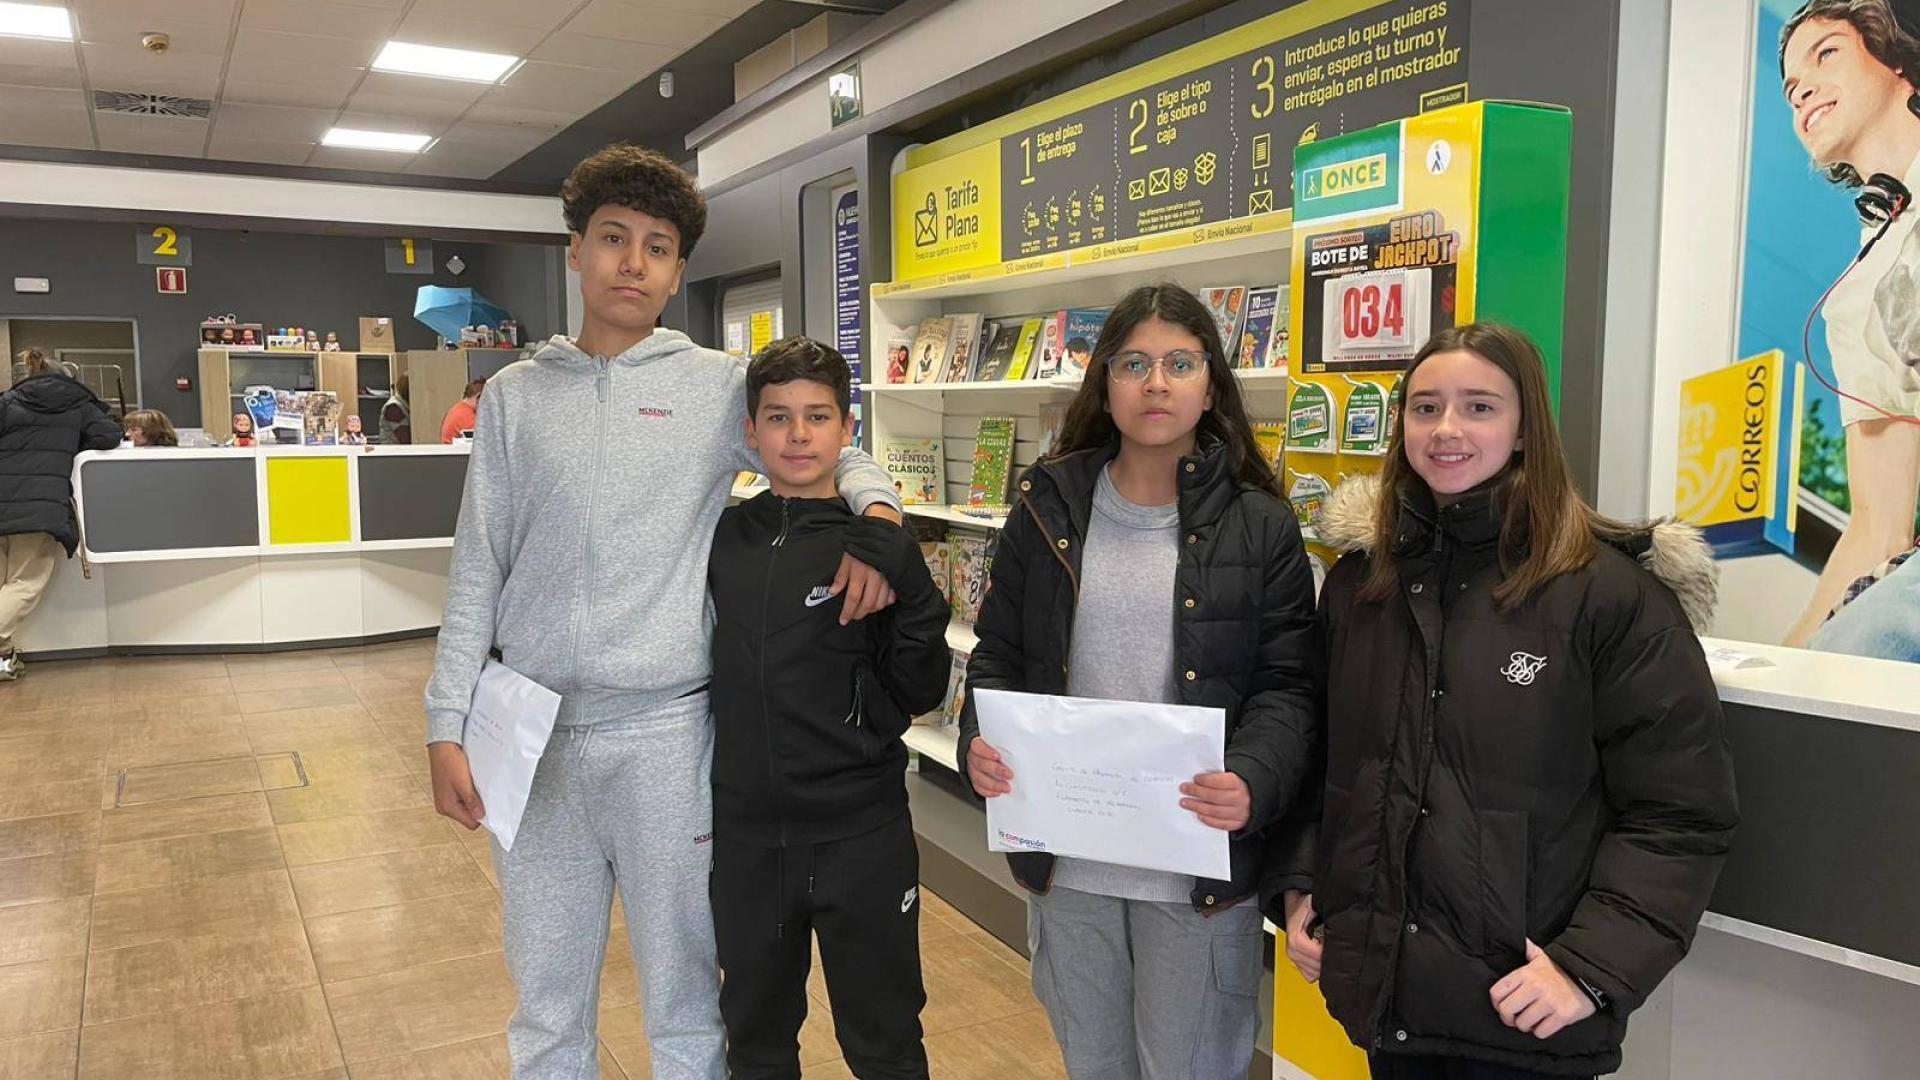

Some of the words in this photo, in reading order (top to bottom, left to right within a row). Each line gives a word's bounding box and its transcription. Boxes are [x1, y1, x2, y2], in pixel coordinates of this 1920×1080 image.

[1284, 35, 1345, 67] Introduce
[1348, 27, 1360, 46] lo
[1363, 22, 1388, 43] que
[1392, 1, 1447, 32] quieras
[1284, 62, 1325, 89] enviar,
[1327, 50, 1372, 76] espera
[1376, 43, 1390, 61] tu
[1393, 32, 1435, 56] turno
[1436, 26, 1447, 48] y
[1251, 55, 1275, 119] 3
[1284, 79, 1344, 112] entrégalo
[1346, 77, 1363, 93] en
[1366, 72, 1377, 88] el
[1380, 47, 1461, 85] mostrador
[1157, 91, 1179, 109] Elige
[1181, 86, 1190, 102] el
[1191, 80, 1211, 99] tipo
[1426, 91, 1462, 107] MOSTRADOR
[1129, 99, 1148, 154] 2
[1157, 111, 1170, 126] de
[1170, 103, 1198, 122] sobre
[1199, 101, 1207, 113] o
[1037, 131, 1054, 148] Elige
[1055, 126, 1062, 142] el
[1063, 123, 1083, 142] plazo
[1157, 126, 1177, 145] caja
[1020, 137, 1035, 185] 1
[1037, 149, 1046, 162] de
[1047, 141, 1076, 158] entrega
[1326, 161, 1380, 190] ONCE
[945, 180, 979, 210] Tarifa
[153, 226, 177, 255] 2
[946, 214, 979, 240] Plana
[1225, 222, 1253, 236] Nacional
[1390, 211, 1436, 244] EURO
[401, 239, 415, 264] 1
[1312, 247, 1347, 266] BOTE
[1350, 245, 1368, 261] DE
[1374, 233, 1453, 269] JACKPOT
[1343, 284, 1404, 339] 034
[1735, 364, 1767, 514] CORREOS
[887, 452, 935, 464] CUENTOS
[811, 586, 831, 598] NIK
